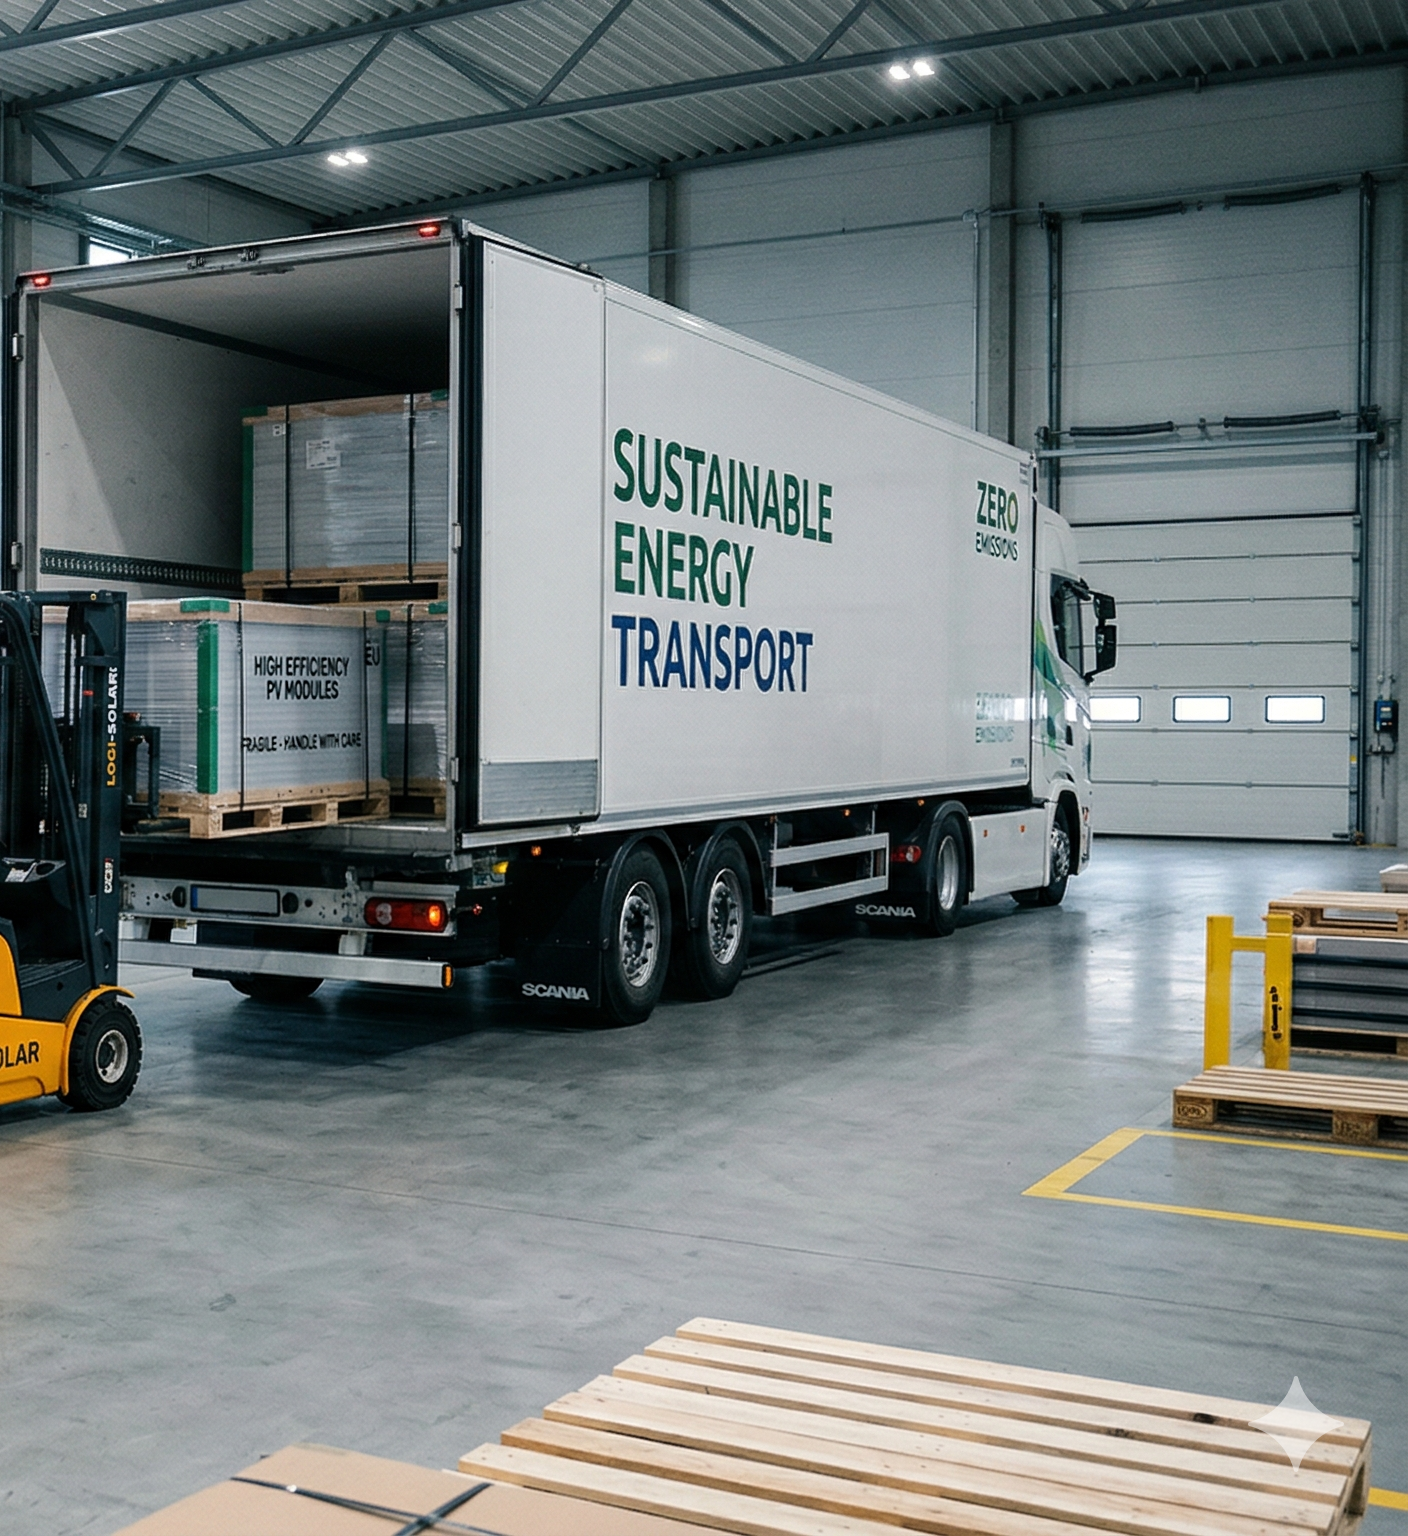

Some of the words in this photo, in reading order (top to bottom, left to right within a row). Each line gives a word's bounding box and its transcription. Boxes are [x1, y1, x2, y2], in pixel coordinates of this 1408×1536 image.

[613, 428, 833, 544] SUSTAINABLE
[977, 480, 1019, 534] ZERO
[614, 521, 755, 608] ENERGY
[254, 655, 283, 676] HIGH
[286, 656, 350, 677] EFFICIENCY
[611, 614, 813, 693] TRANSPORT
[266, 680, 282, 700] PV
[284, 680, 339, 700] MODULES
[855, 904, 916, 918] SCANIA
[522, 983, 590, 1000] SCANIA
